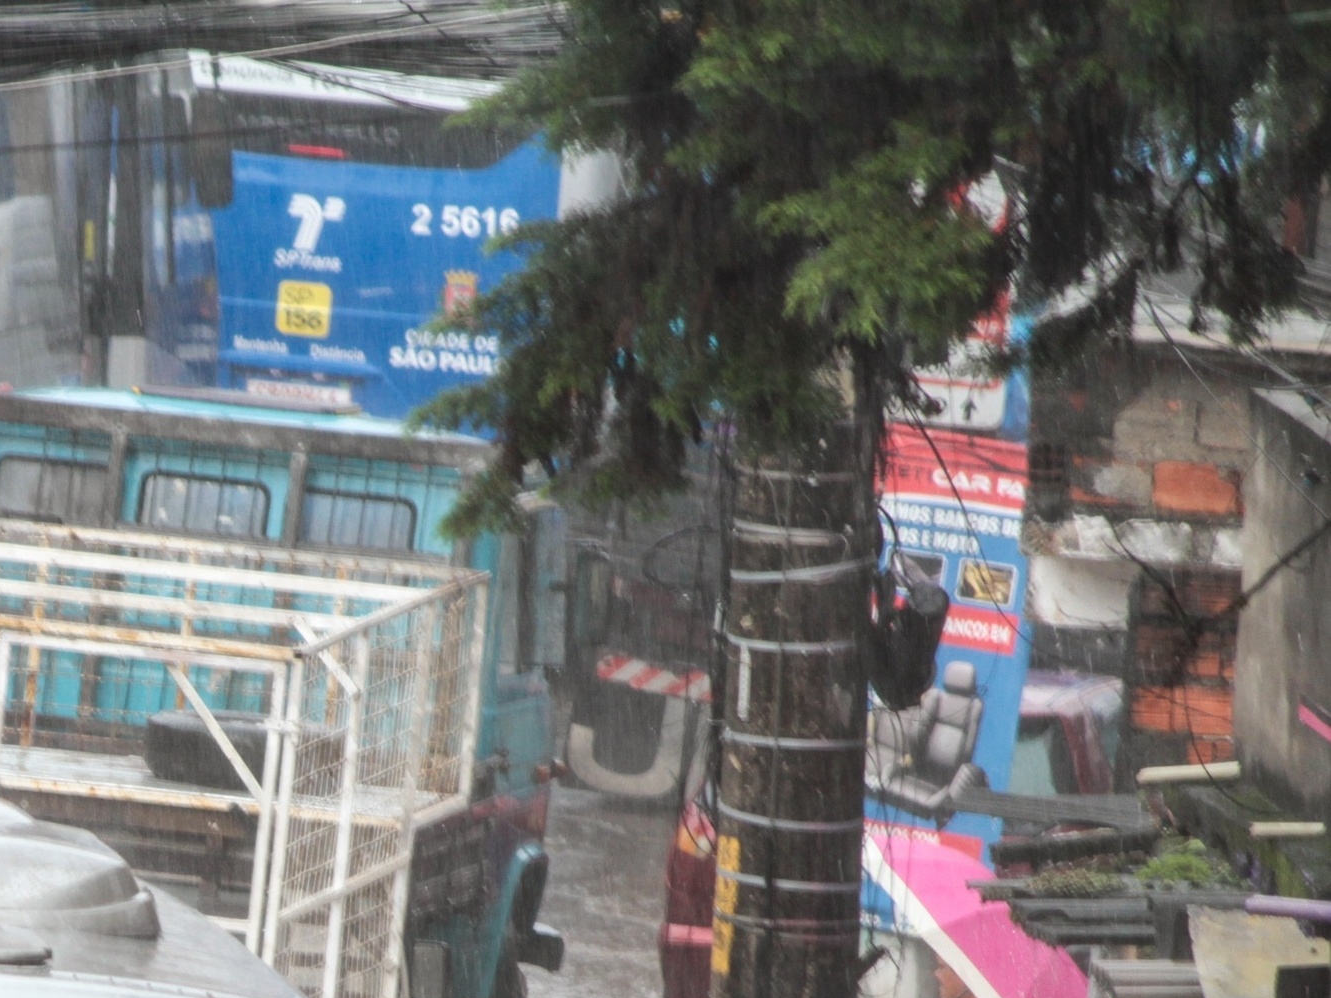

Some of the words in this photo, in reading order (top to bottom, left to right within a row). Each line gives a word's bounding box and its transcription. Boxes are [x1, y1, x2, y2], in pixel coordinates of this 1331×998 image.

[411, 203, 433, 236] 2
[441, 204, 520, 238] 5616
[284, 285, 313, 305] SP
[284, 308, 323, 330] 156
[439, 351, 503, 376] PAUL
[932, 468, 992, 494] CAR
[933, 508, 1001, 536] BANCOS
[943, 617, 989, 641] ANCOS
